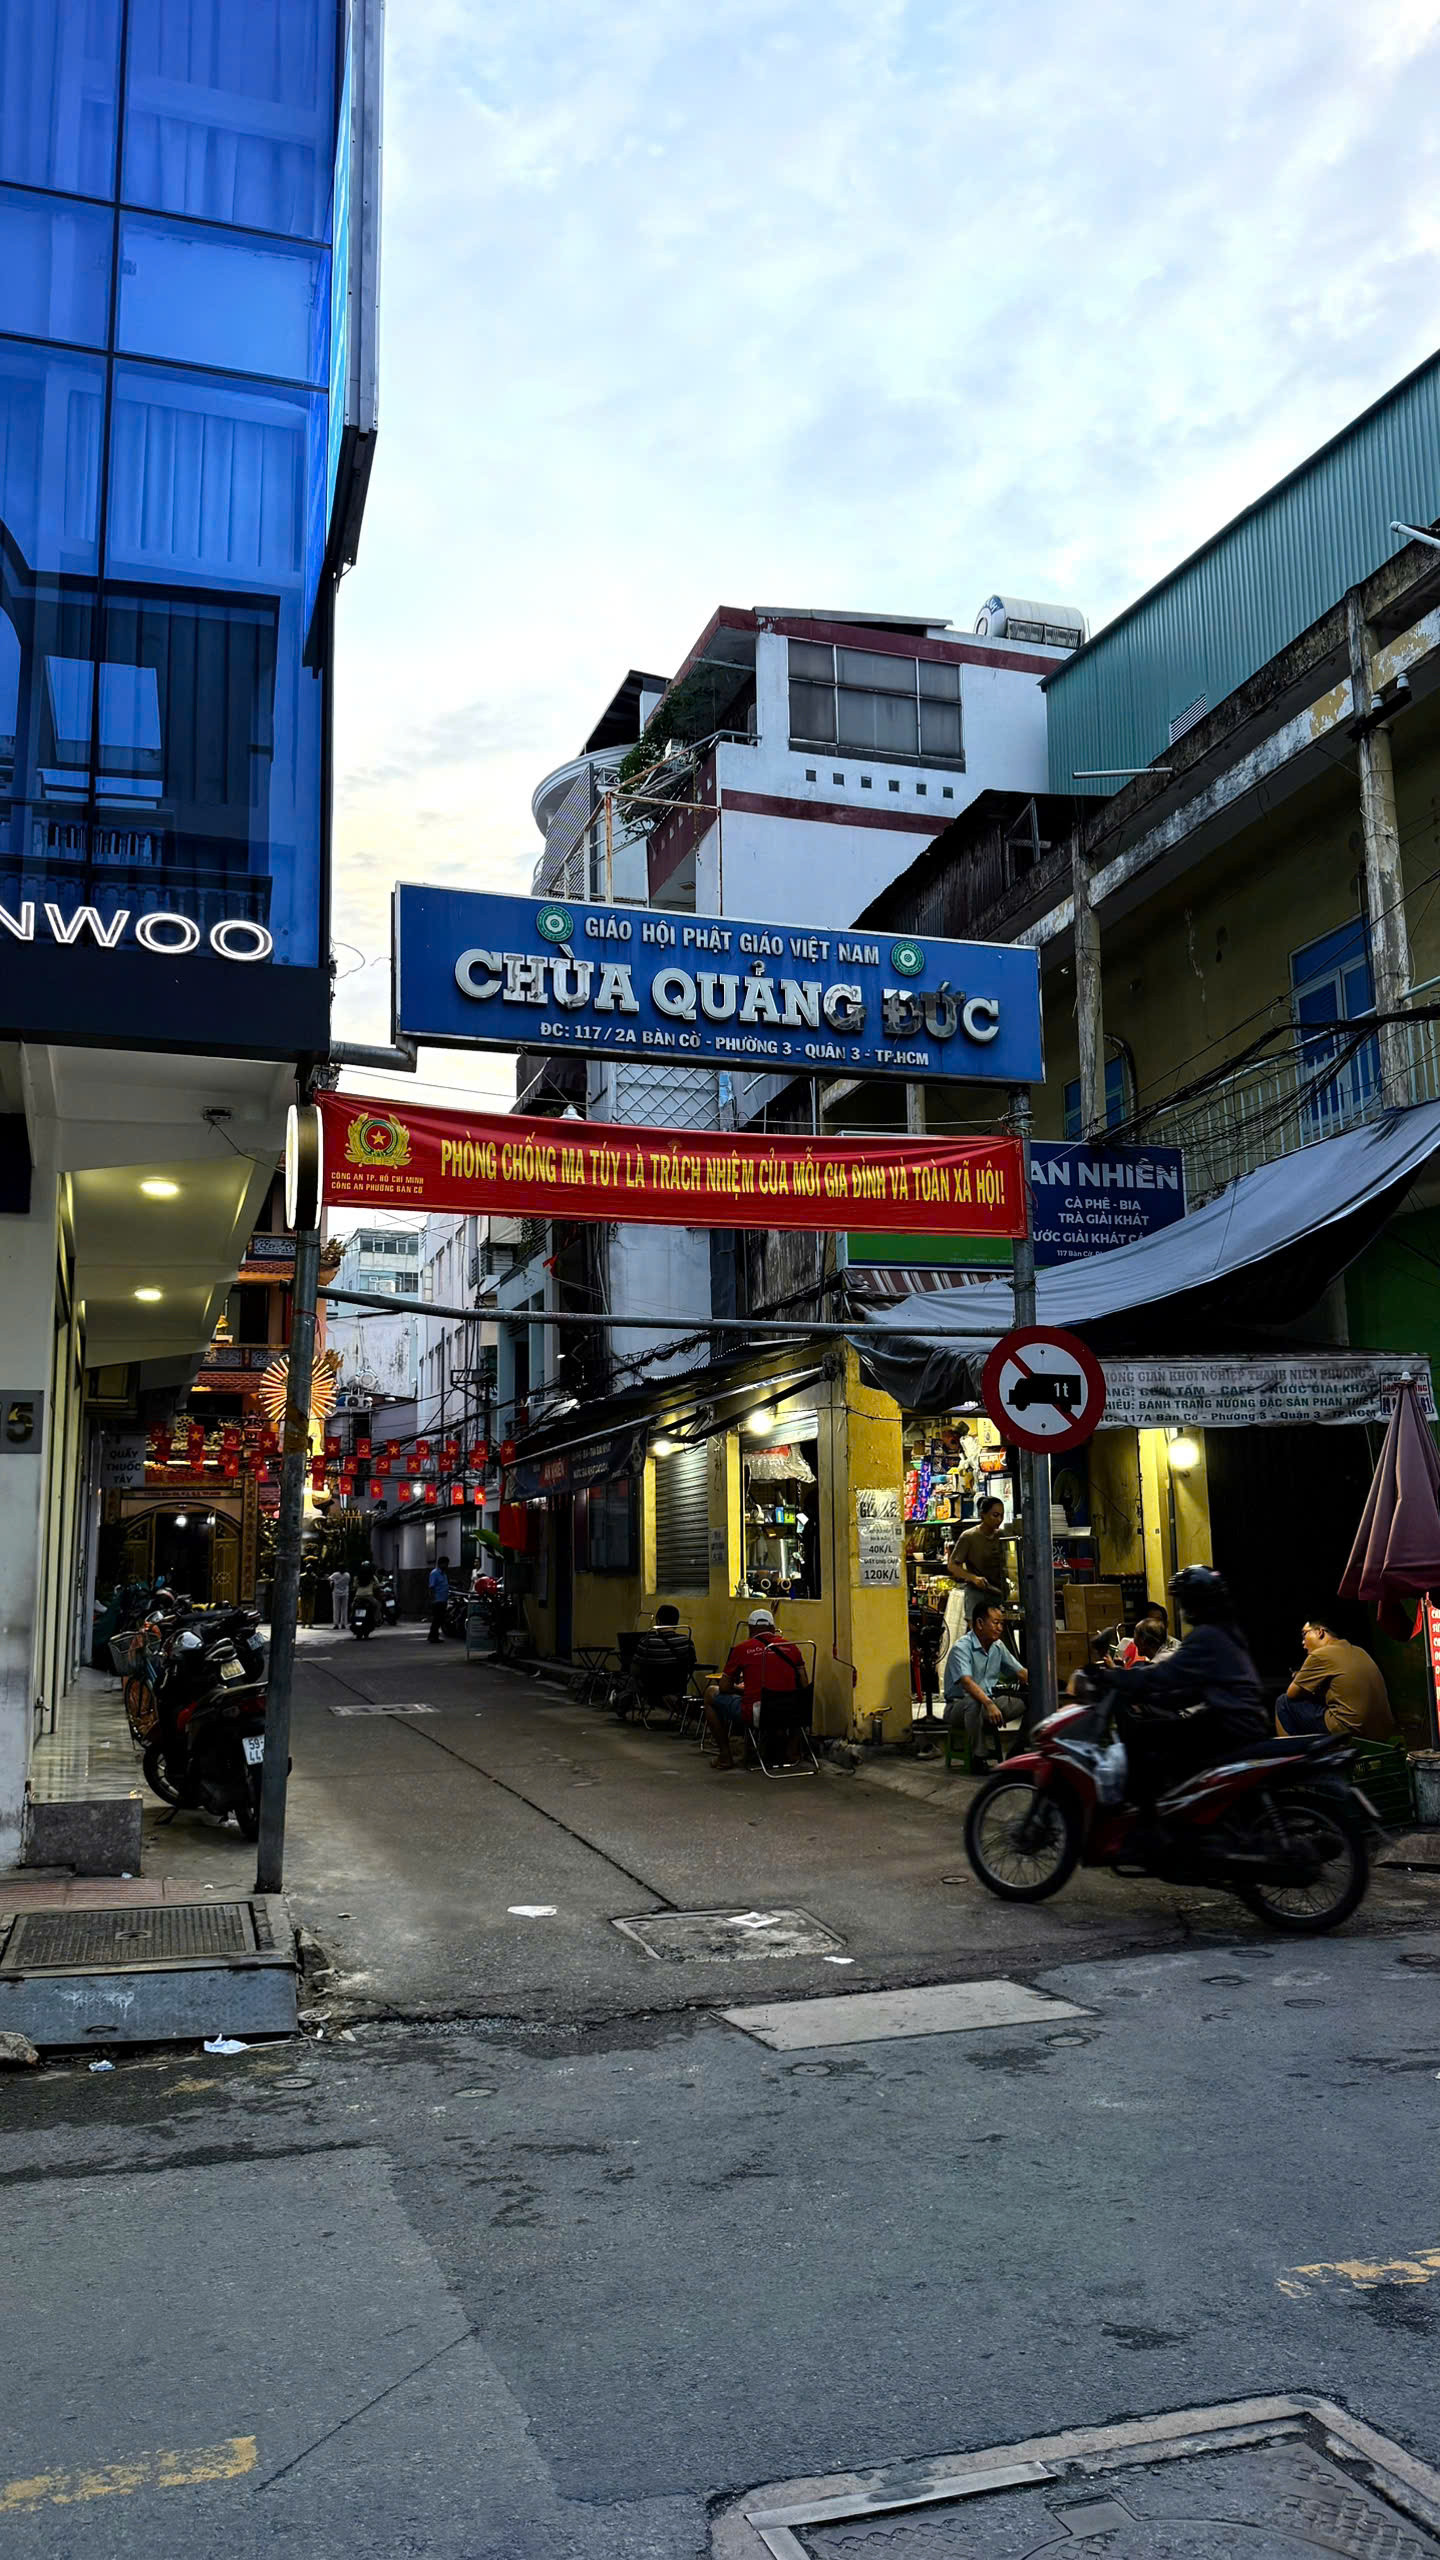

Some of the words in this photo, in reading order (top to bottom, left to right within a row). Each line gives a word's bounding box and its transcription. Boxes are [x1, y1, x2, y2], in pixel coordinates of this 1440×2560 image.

[585, 914, 632, 940] GIÁO
[642, 919, 676, 949] HỘI
[683, 925, 732, 953] PHẬT
[739, 930, 783, 956] GIÁO
[790, 936, 830, 963] VIỆT
[838, 943, 880, 965] NAM
[454, 943, 639, 1012] CHÙA
[652, 960, 867, 1032] QUẢNG
[881, 981, 1000, 1044] ĐỨC
[540, 1021, 570, 1038] ĐC:
[642, 1027, 676, 1047] BÀN
[679, 1031, 702, 1048] CỜ
[715, 1034, 778, 1056] PHƯỜNG
[782, 1041, 792, 1055] 3
[851, 1047, 861, 1060] 3
[875, 1049, 930, 1066] TP.HCM
[331, 1171, 351, 1181] CÔNG
[353, 1172, 364, 1181] AN
[366, 1173, 378, 1182] TP.
[405, 1175, 424, 1185] MINH
[440, 1130, 497, 1180] PHÒNG
[501, 1131, 556, 1183] CHỐNG
[561, 1147, 586, 1185] MA
[589, 1141, 621, 1187] TÚY
[626, 1143, 646, 1188] LÀ
[650, 1145, 701, 1191] TRÁCH
[706, 1149, 755, 1201] NHIỆM
[758, 1147, 789, 1196] CỦA
[792, 1145, 821, 1197] MỖI
[824, 1162, 848, 1198] GIA
[851, 1155, 886, 1200] ĐÌNH
[889, 1157, 909, 1201] VÀ
[912, 1158, 950, 1202] TOÀN
[953, 1160, 972, 1203] XÃ
[976, 1160, 1006, 1211] HỘI!
[1031, 1160, 1071, 1186] AN
[1078, 1157, 1178, 1190] NHIÊN
[331, 1180, 351, 1190] CÔNG
[353, 1182, 364, 1191] AN
[1065, 1195, 1083, 1209] CÀ
[1085, 1196, 1111, 1210] PHÊ
[1120, 1200, 1141, 1211] BIA
[1058, 1211, 1084, 1224] TRÀ
[1114, 1212, 1150, 1226] KHÁT
[1033, 1228, 1061, 1242] ƯỚC
[1091, 1231, 1127, 1244] KHÁT
[1370, 1368, 1377, 1380] 3
[1053, 1381, 1069, 1398] 1t
[1139, 1397, 1171, 1410] BÁNH
[1286, 1395, 1309, 1407] SẢN
[1313, 1397, 1343, 1407] PHAN
[1124, 1414, 1152, 1422] 117A
[1156, 1412, 1180, 1422] Bàn
[1259, 1411, 1266, 1420] 3
[1313, 1410, 1321, 1419] 3
[105, 1459, 141, 1471] THUỐC
[868, 1544, 893, 1554] 40K/L
[864, 1568, 900, 1581] 120K/L
